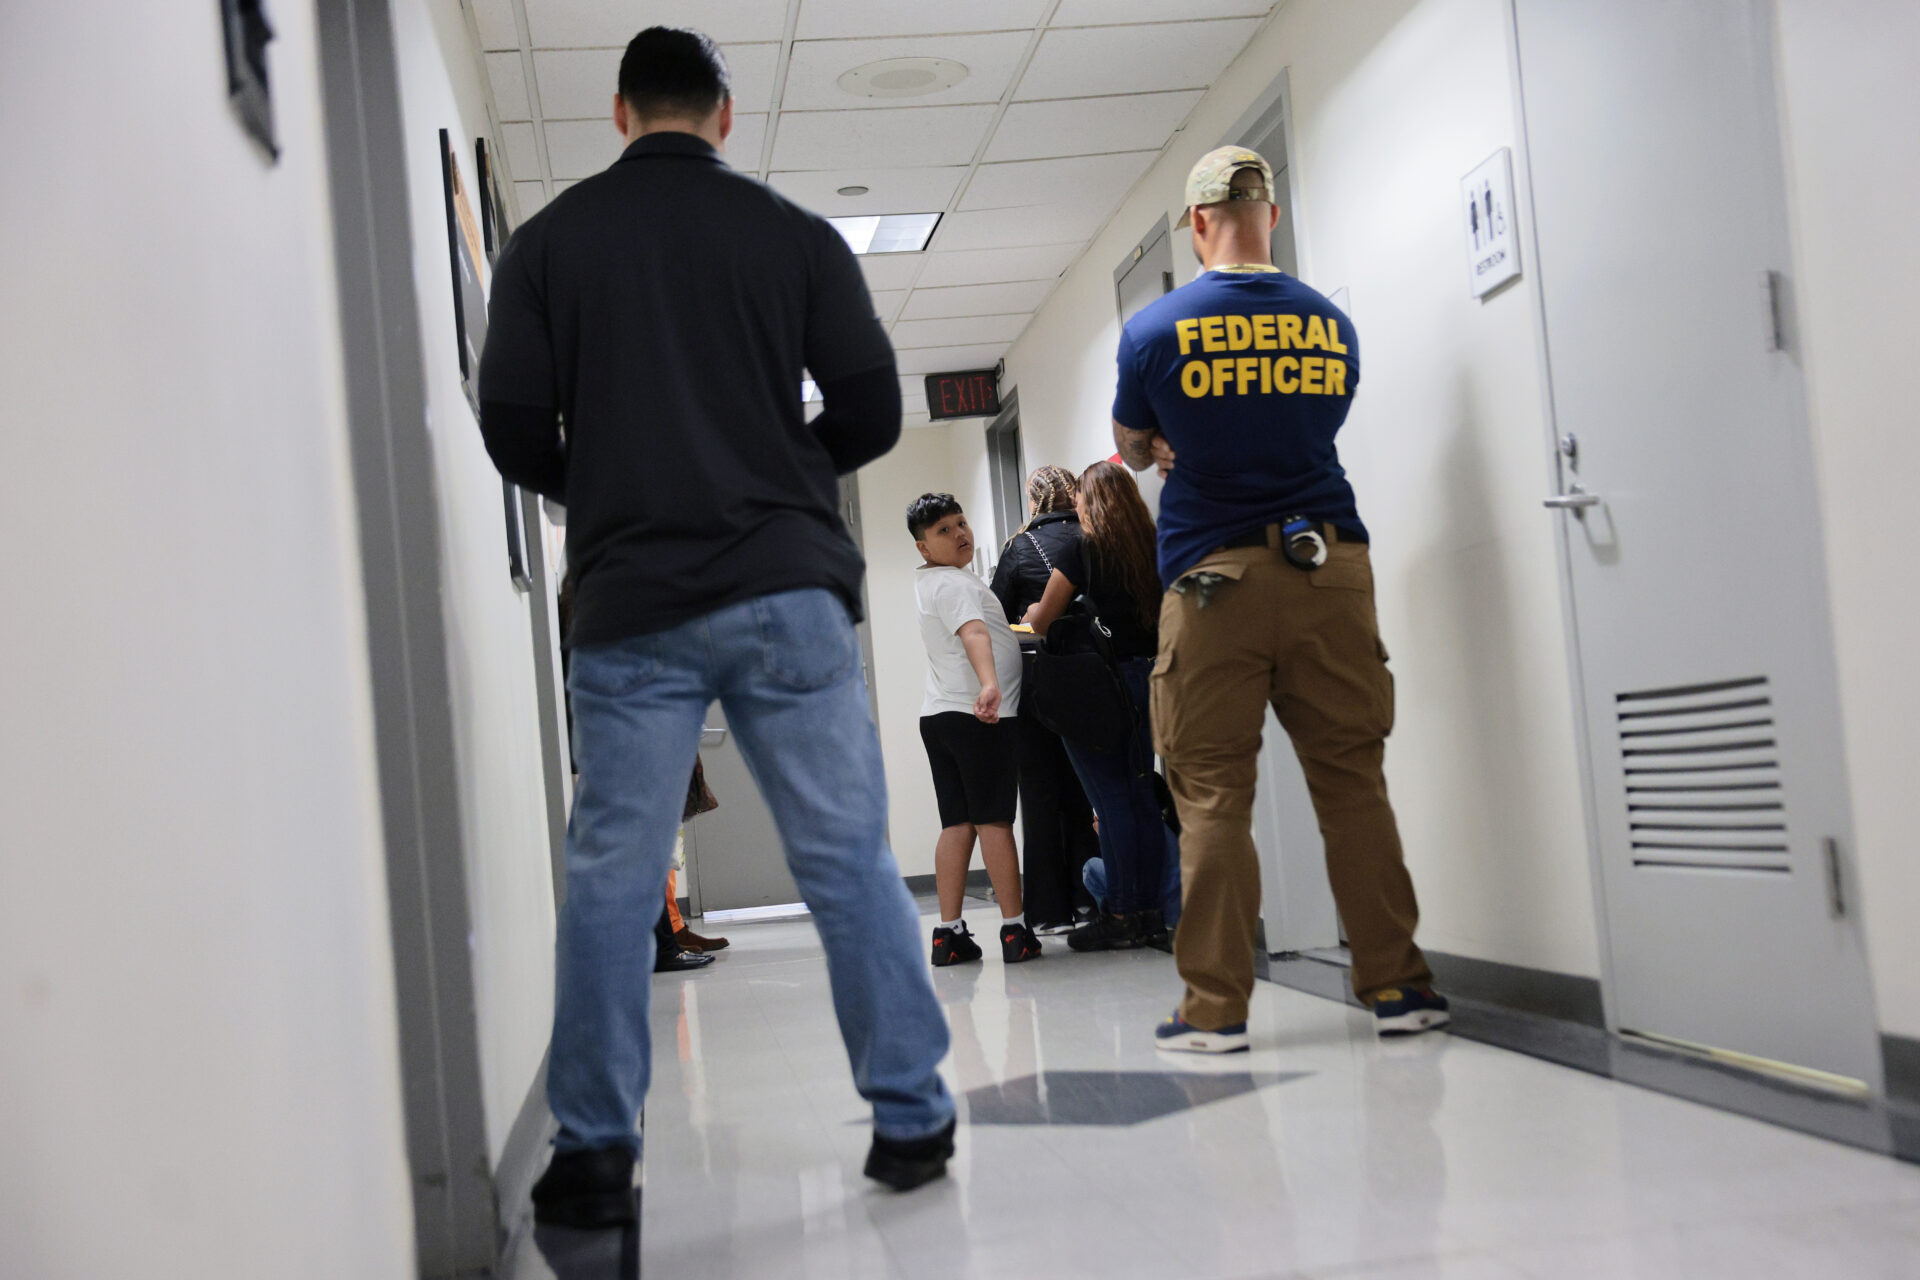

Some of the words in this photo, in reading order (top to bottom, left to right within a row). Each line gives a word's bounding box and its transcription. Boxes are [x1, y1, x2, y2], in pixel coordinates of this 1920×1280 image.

[1175, 314, 1347, 355] FEDERAL
[939, 376, 985, 413] EXIT
[1180, 356, 1347, 398] OFFICER
